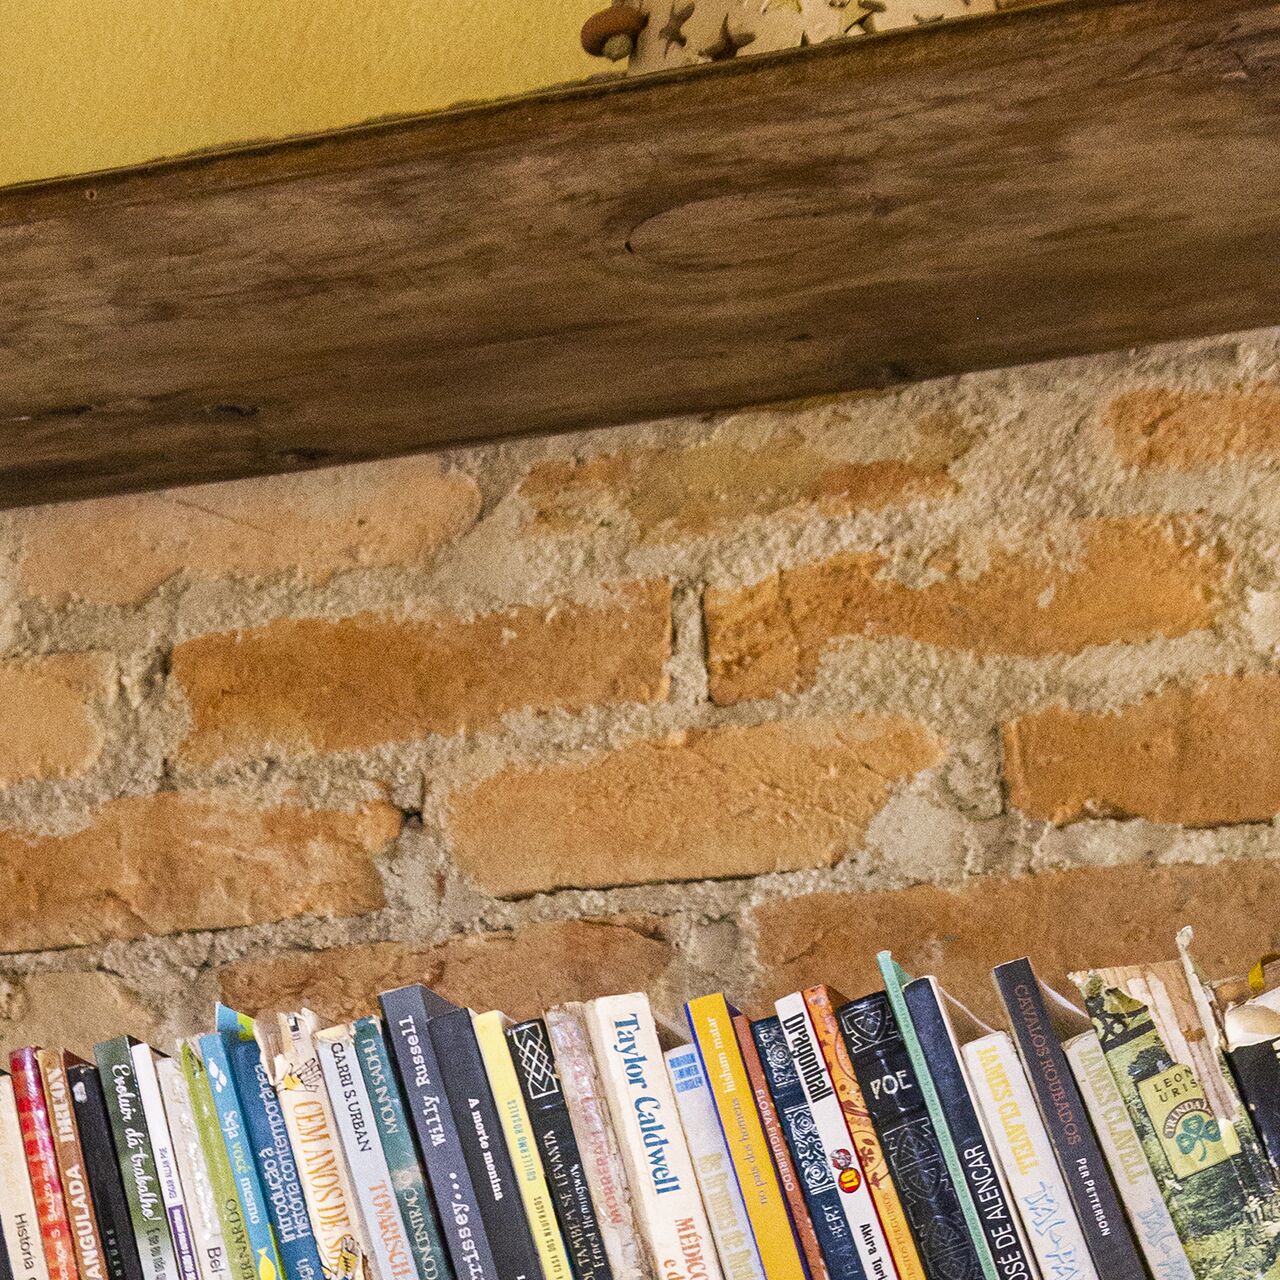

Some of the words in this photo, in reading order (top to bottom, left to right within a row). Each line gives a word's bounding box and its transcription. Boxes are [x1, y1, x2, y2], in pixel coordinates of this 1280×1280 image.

[398, 1014, 431, 1087] Russell
[706, 1016, 727, 1052] matar
[783, 1010, 835, 1104] Dragonball
[361, 1038, 386, 1086] SADHU
[717, 1051, 738, 1096] hisham
[869, 1069, 914, 1100] POE
[1014, 983, 1051, 1058] CAVALOS
[1039, 1059, 1082, 1146] ROUBADOS
[1153, 1065, 1194, 1093] LEON
[111, 1063, 133, 1122] Evoluir
[375, 1087, 400, 1135] MOUNI
[467, 1098, 480, 1108] A
[614, 1012, 649, 1090] Taylor
[634, 1095, 682, 1195] Caldwell
[976, 1045, 1014, 1102] JAMES
[997, 1099, 1042, 1177] CLAVELL
[1158, 1079, 1199, 1103] URIS
[124, 1126, 145, 1150] dá
[223, 1110, 240, 1140] Seja
[255, 1062, 300, 1183] contemporânea
[293, 1099, 330, 1143] CEM
[423, 1095, 447, 1147] Willy
[471, 1111, 492, 1150] morte
[756, 1087, 775, 1127] FLORA
[767, 1128, 797, 1193] FIGUEIREDO
[1080, 1047, 1113, 1102] JAMES
[1102, 1101, 1149, 1186] CLAVELL
[231, 1141, 254, 1175] você
[259, 1146, 273, 1159] à
[303, 1146, 344, 1201] ANOS
[129, 1146, 161, 1223] trabalho!
[239, 1176, 260, 1224] mesmo
[265, 1157, 296, 1243] introdução
[963, 1144, 1008, 1220] ALENCAR
[1075, 1157, 1091, 1178] PER
[1083, 1178, 1111, 1237] PETTERSON
[284, 1182, 311, 1239] história
[317, 1201, 351, 1232] DE
[14, 1212, 35, 1272] História
[859, 1221, 878, 1257] Akira
[990, 1222, 1017, 1251] DE
[663, 1258, 674, 1270] e
